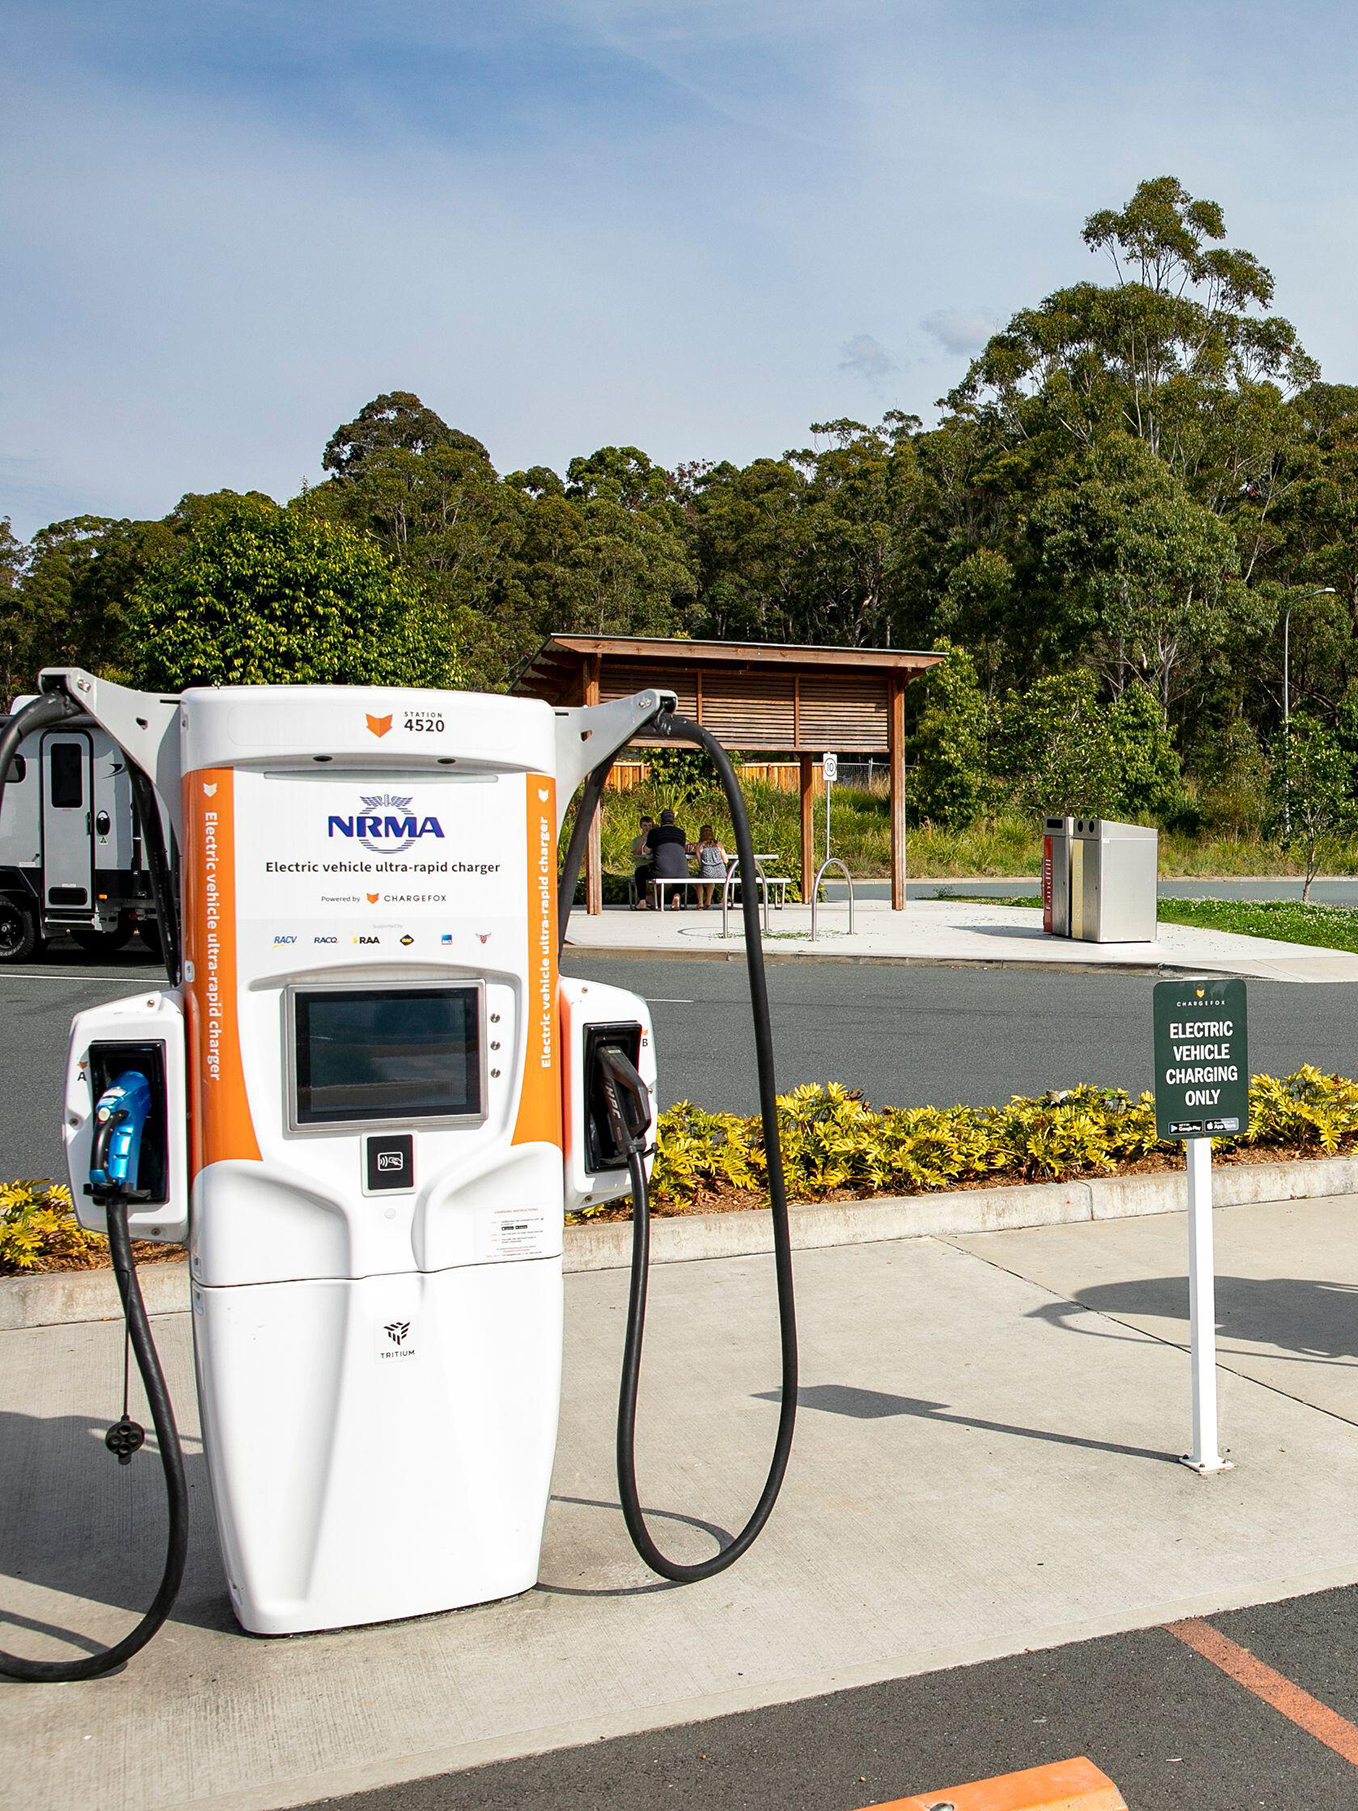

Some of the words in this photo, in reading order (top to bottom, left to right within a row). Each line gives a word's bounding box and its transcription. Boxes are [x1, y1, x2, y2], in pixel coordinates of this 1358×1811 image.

[404, 719, 445, 733] 4520
[328, 815, 445, 838] NRMA
[204, 812, 217, 871] Electric
[538, 817, 550, 874] charger
[266, 861, 319, 873] Electric
[323, 861, 372, 873] vehicle
[376, 861, 448, 876] ultra-rapid
[451, 861, 500, 876] charger
[206, 876, 220, 929] vehicle
[321, 895, 350, 903] Powered
[352, 895, 361, 903] by
[384, 894, 447, 902] CHARGEFOX
[538, 877, 550, 955] ultra-rapid
[274, 936, 298, 944] RACV
[314, 936, 338, 944] RACQ
[359, 936, 381, 944] RAA
[206, 933, 221, 1017] ultra-rapid
[540, 958, 550, 1014] vehicle
[1169, 1021, 1233, 1039] ELECTRIC
[206, 1020, 221, 1081] charger
[540, 1016, 551, 1068] Electric
[642, 1038, 649, 1047] B
[1173, 1043, 1231, 1061] VEHICLE
[77, 1072, 87, 1081] A
[1165, 1066, 1238, 1085] CHARGING
[1185, 1089, 1221, 1106] ONLY
[380, 1349, 415, 1358] TRITIUM
